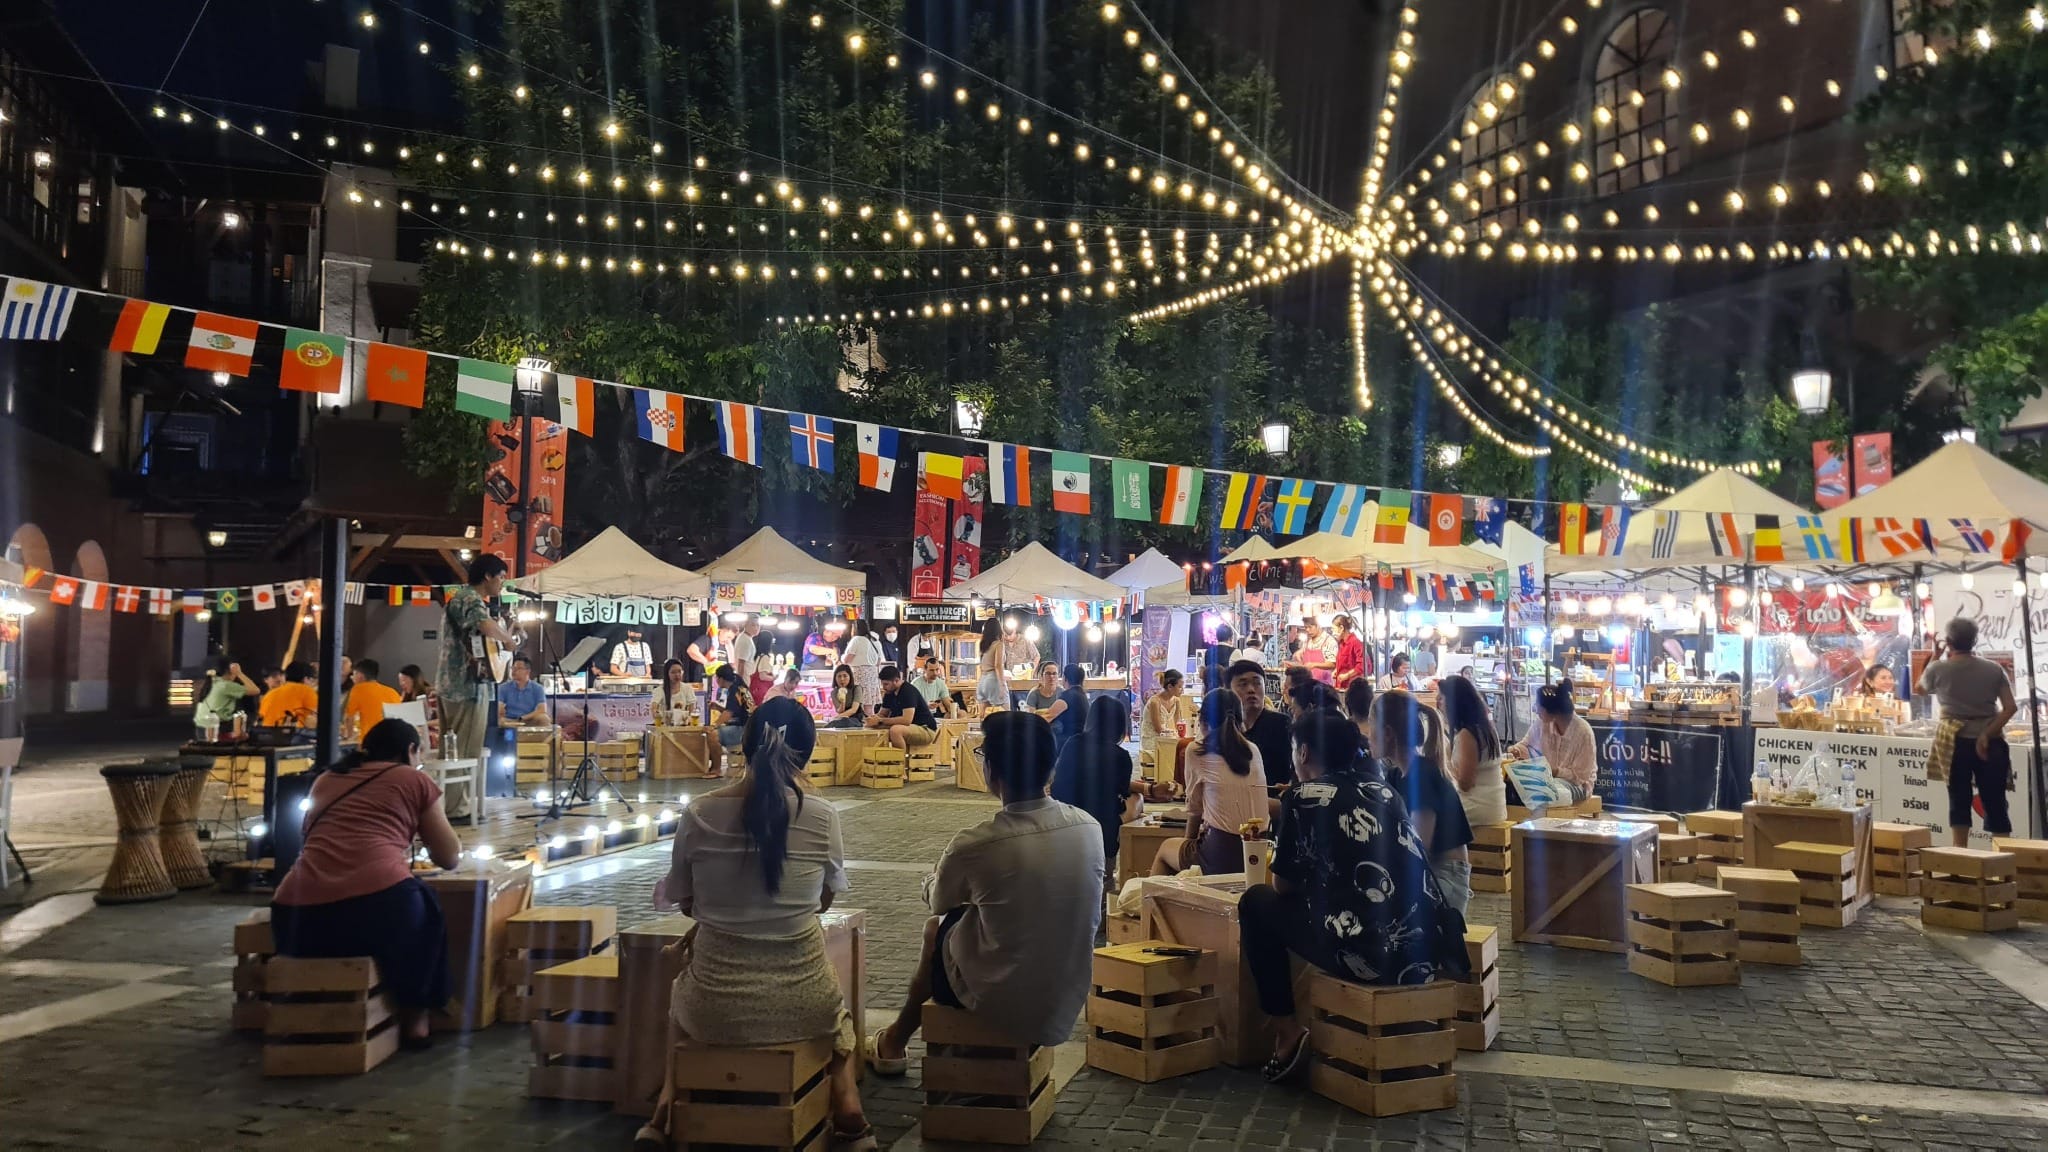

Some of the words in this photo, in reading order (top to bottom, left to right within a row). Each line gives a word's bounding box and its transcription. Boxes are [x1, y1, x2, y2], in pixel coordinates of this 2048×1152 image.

[1758, 738, 1813, 751] CHICKEN
[1828, 743, 1878, 756] HICKEN
[1886, 747, 1929, 758] AMERIC
[1768, 753, 1801, 765] WING
[1836, 758, 1867, 770] TCK
[1898, 759, 1926, 769] STLY
[1902, 797, 1930, 811] อร่อย
